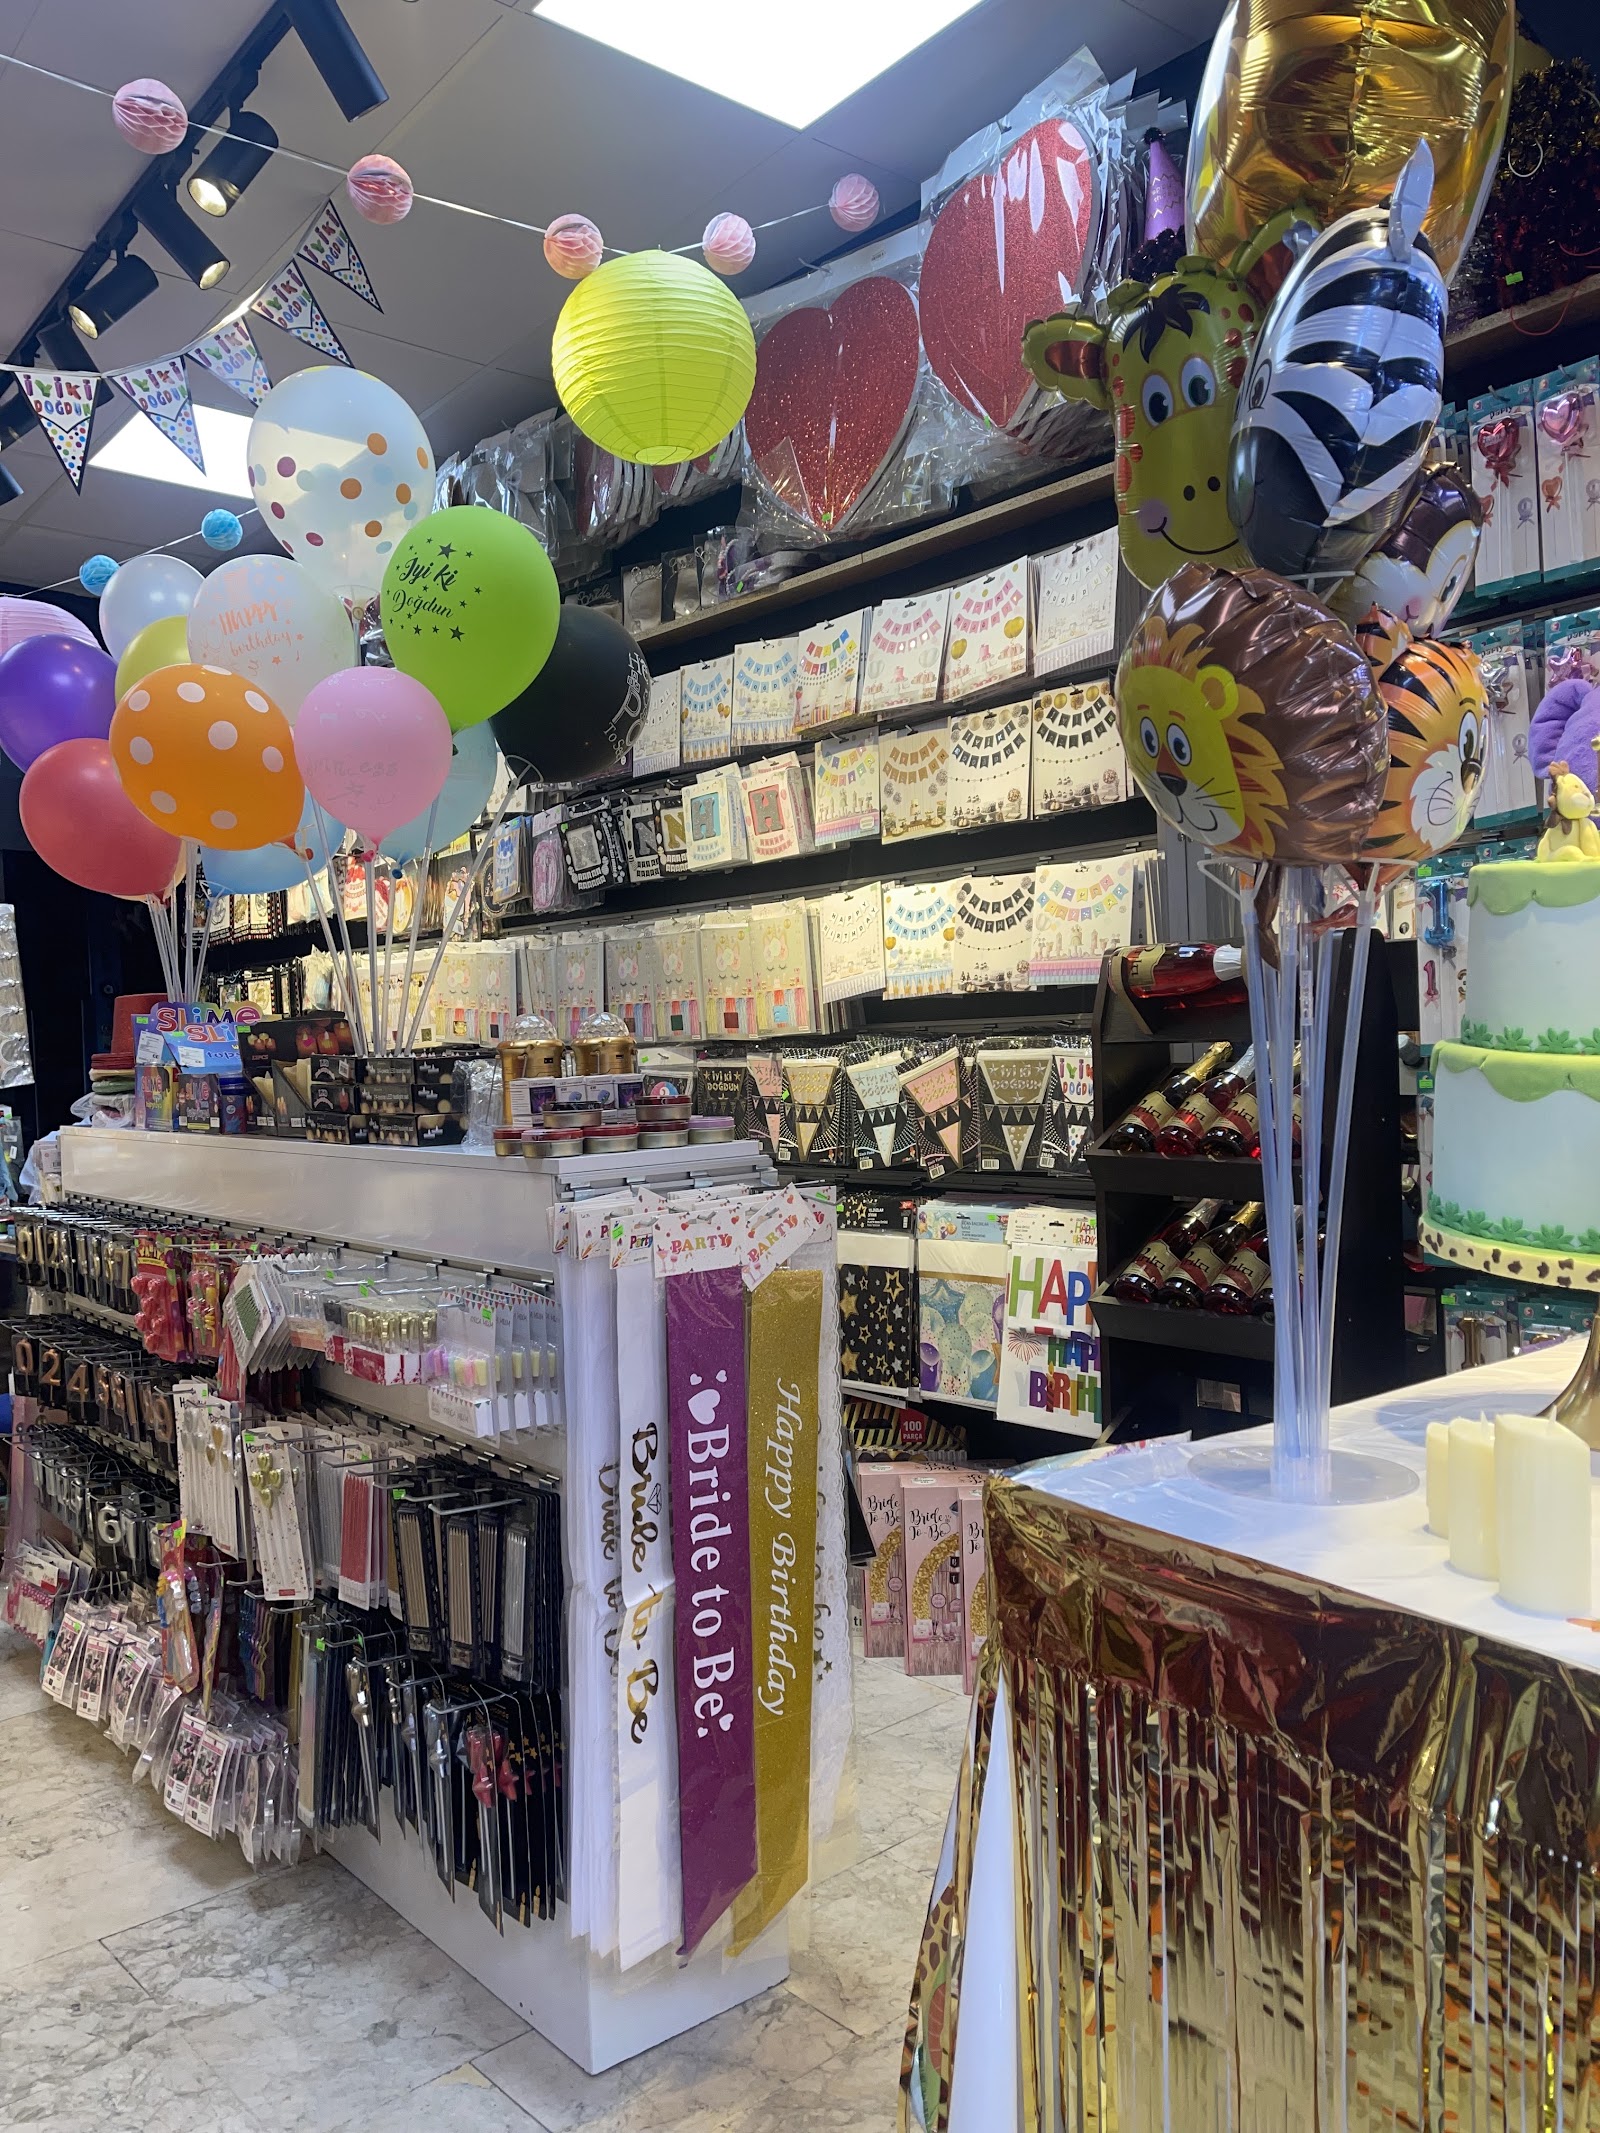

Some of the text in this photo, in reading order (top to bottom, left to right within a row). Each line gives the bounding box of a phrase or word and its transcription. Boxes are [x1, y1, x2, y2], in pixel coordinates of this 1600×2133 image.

[392, 589, 454, 618] Doğdun
[691, 797, 717, 841] H
[752, 790, 784, 834] H
[831, 901, 867, 923] HAPPY
[897, 899, 943, 920] HAPPY
[959, 898, 1034, 932] BIRTHDAY
[970, 890, 1022, 912] HAPPY
[823, 907, 876, 939] BIRTHDAY
[888, 908, 954, 937] BIRTHDAY
[671, 1233, 733, 1255] PARTY
[747, 1213, 799, 1263] PARTY
[902, 1432, 924, 1441] PARÇA
[903, 1420, 922, 1432] 100
[630, 1421, 660, 1574] Bride
[866, 1493, 900, 1513] Bride
[97, 1501, 121, 1545] 6
[908, 1507, 944, 1527] Bride
[757, 1376, 803, 1717] Happy Birthday
[687, 1423, 736, 1721] Bride to Be
[626, 1658, 660, 1745] Be
